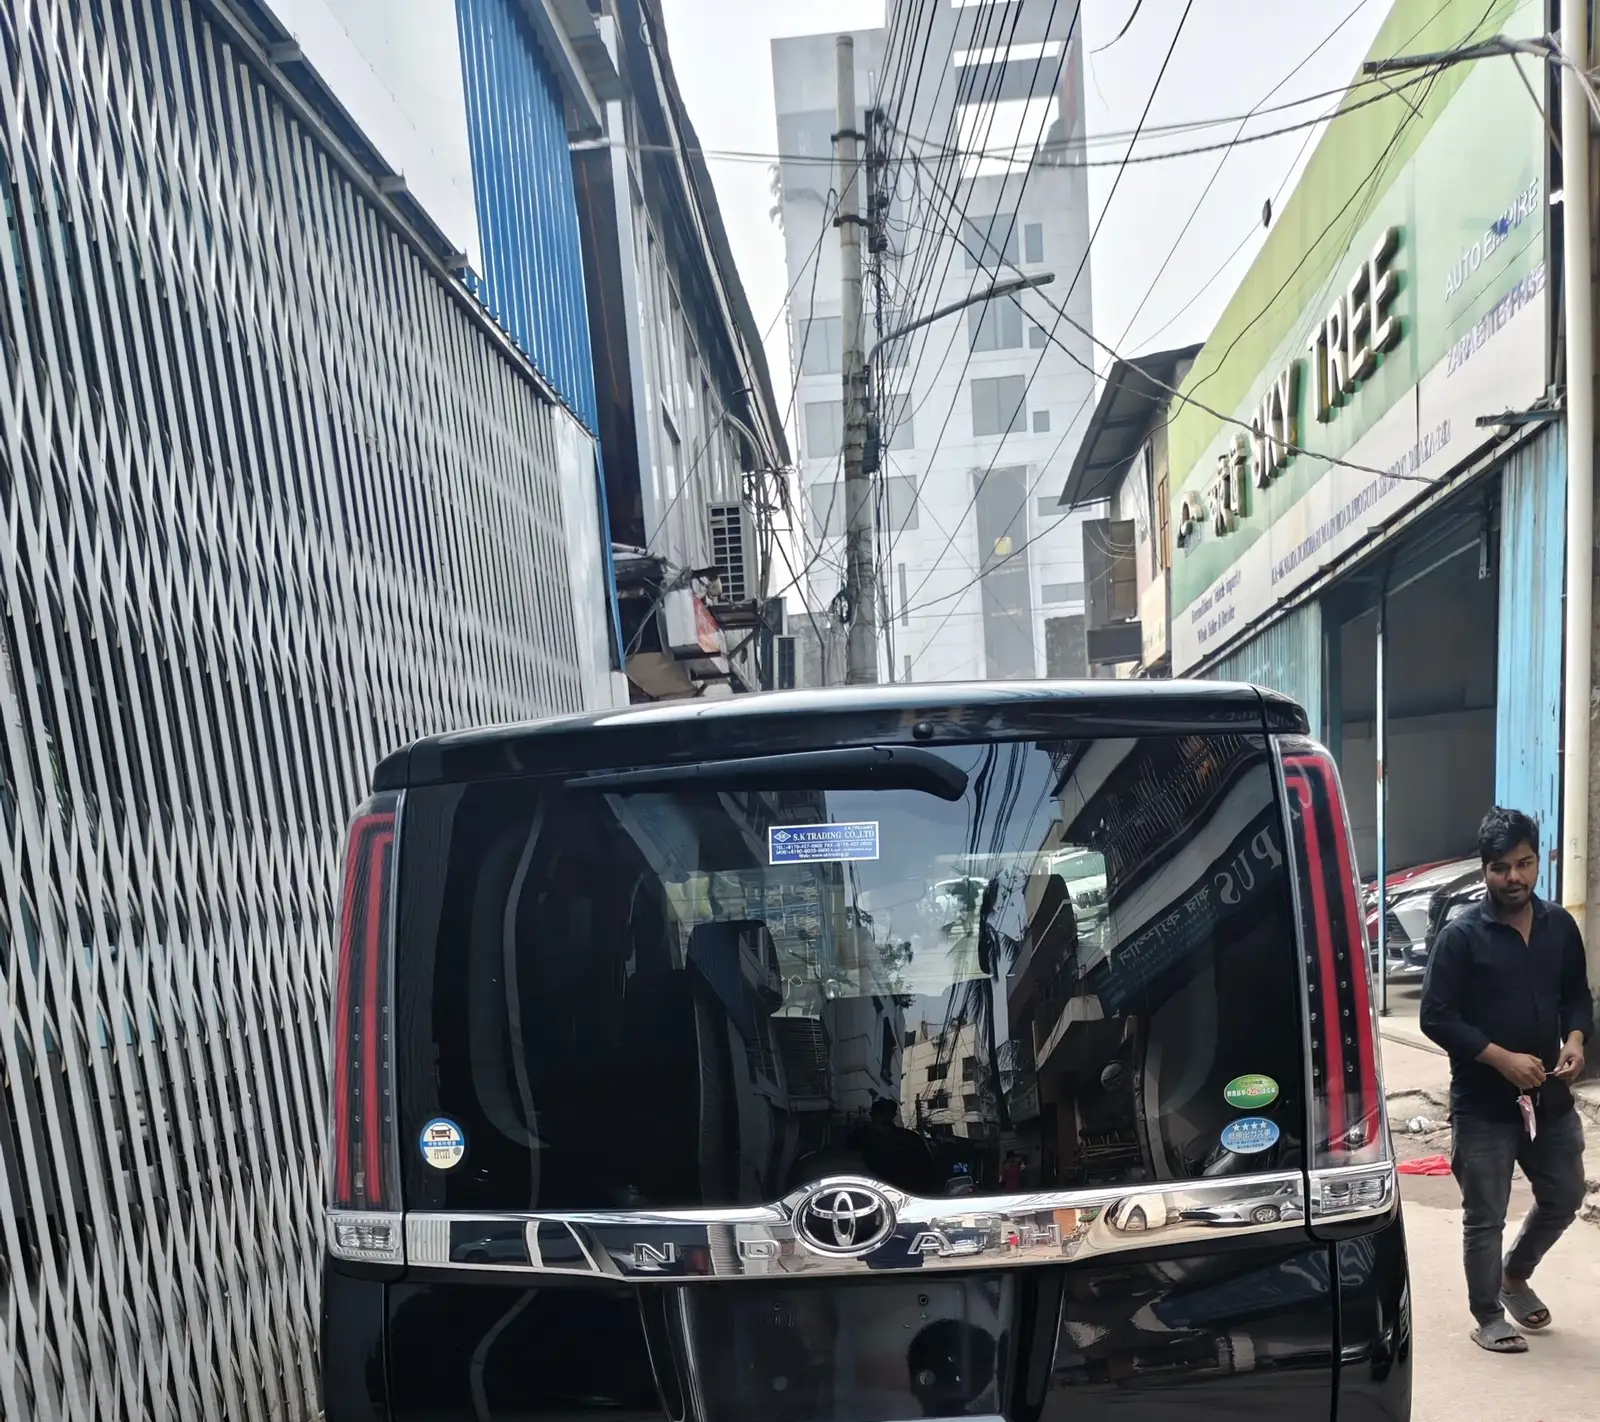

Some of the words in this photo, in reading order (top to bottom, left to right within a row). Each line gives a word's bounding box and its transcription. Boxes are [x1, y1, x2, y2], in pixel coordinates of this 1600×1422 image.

[1445, 241, 1482, 303] AUTO
[1250, 358, 1301, 490] SKY
[1306, 225, 1401, 424] TREE
[807, 831, 842, 841] TRADING
